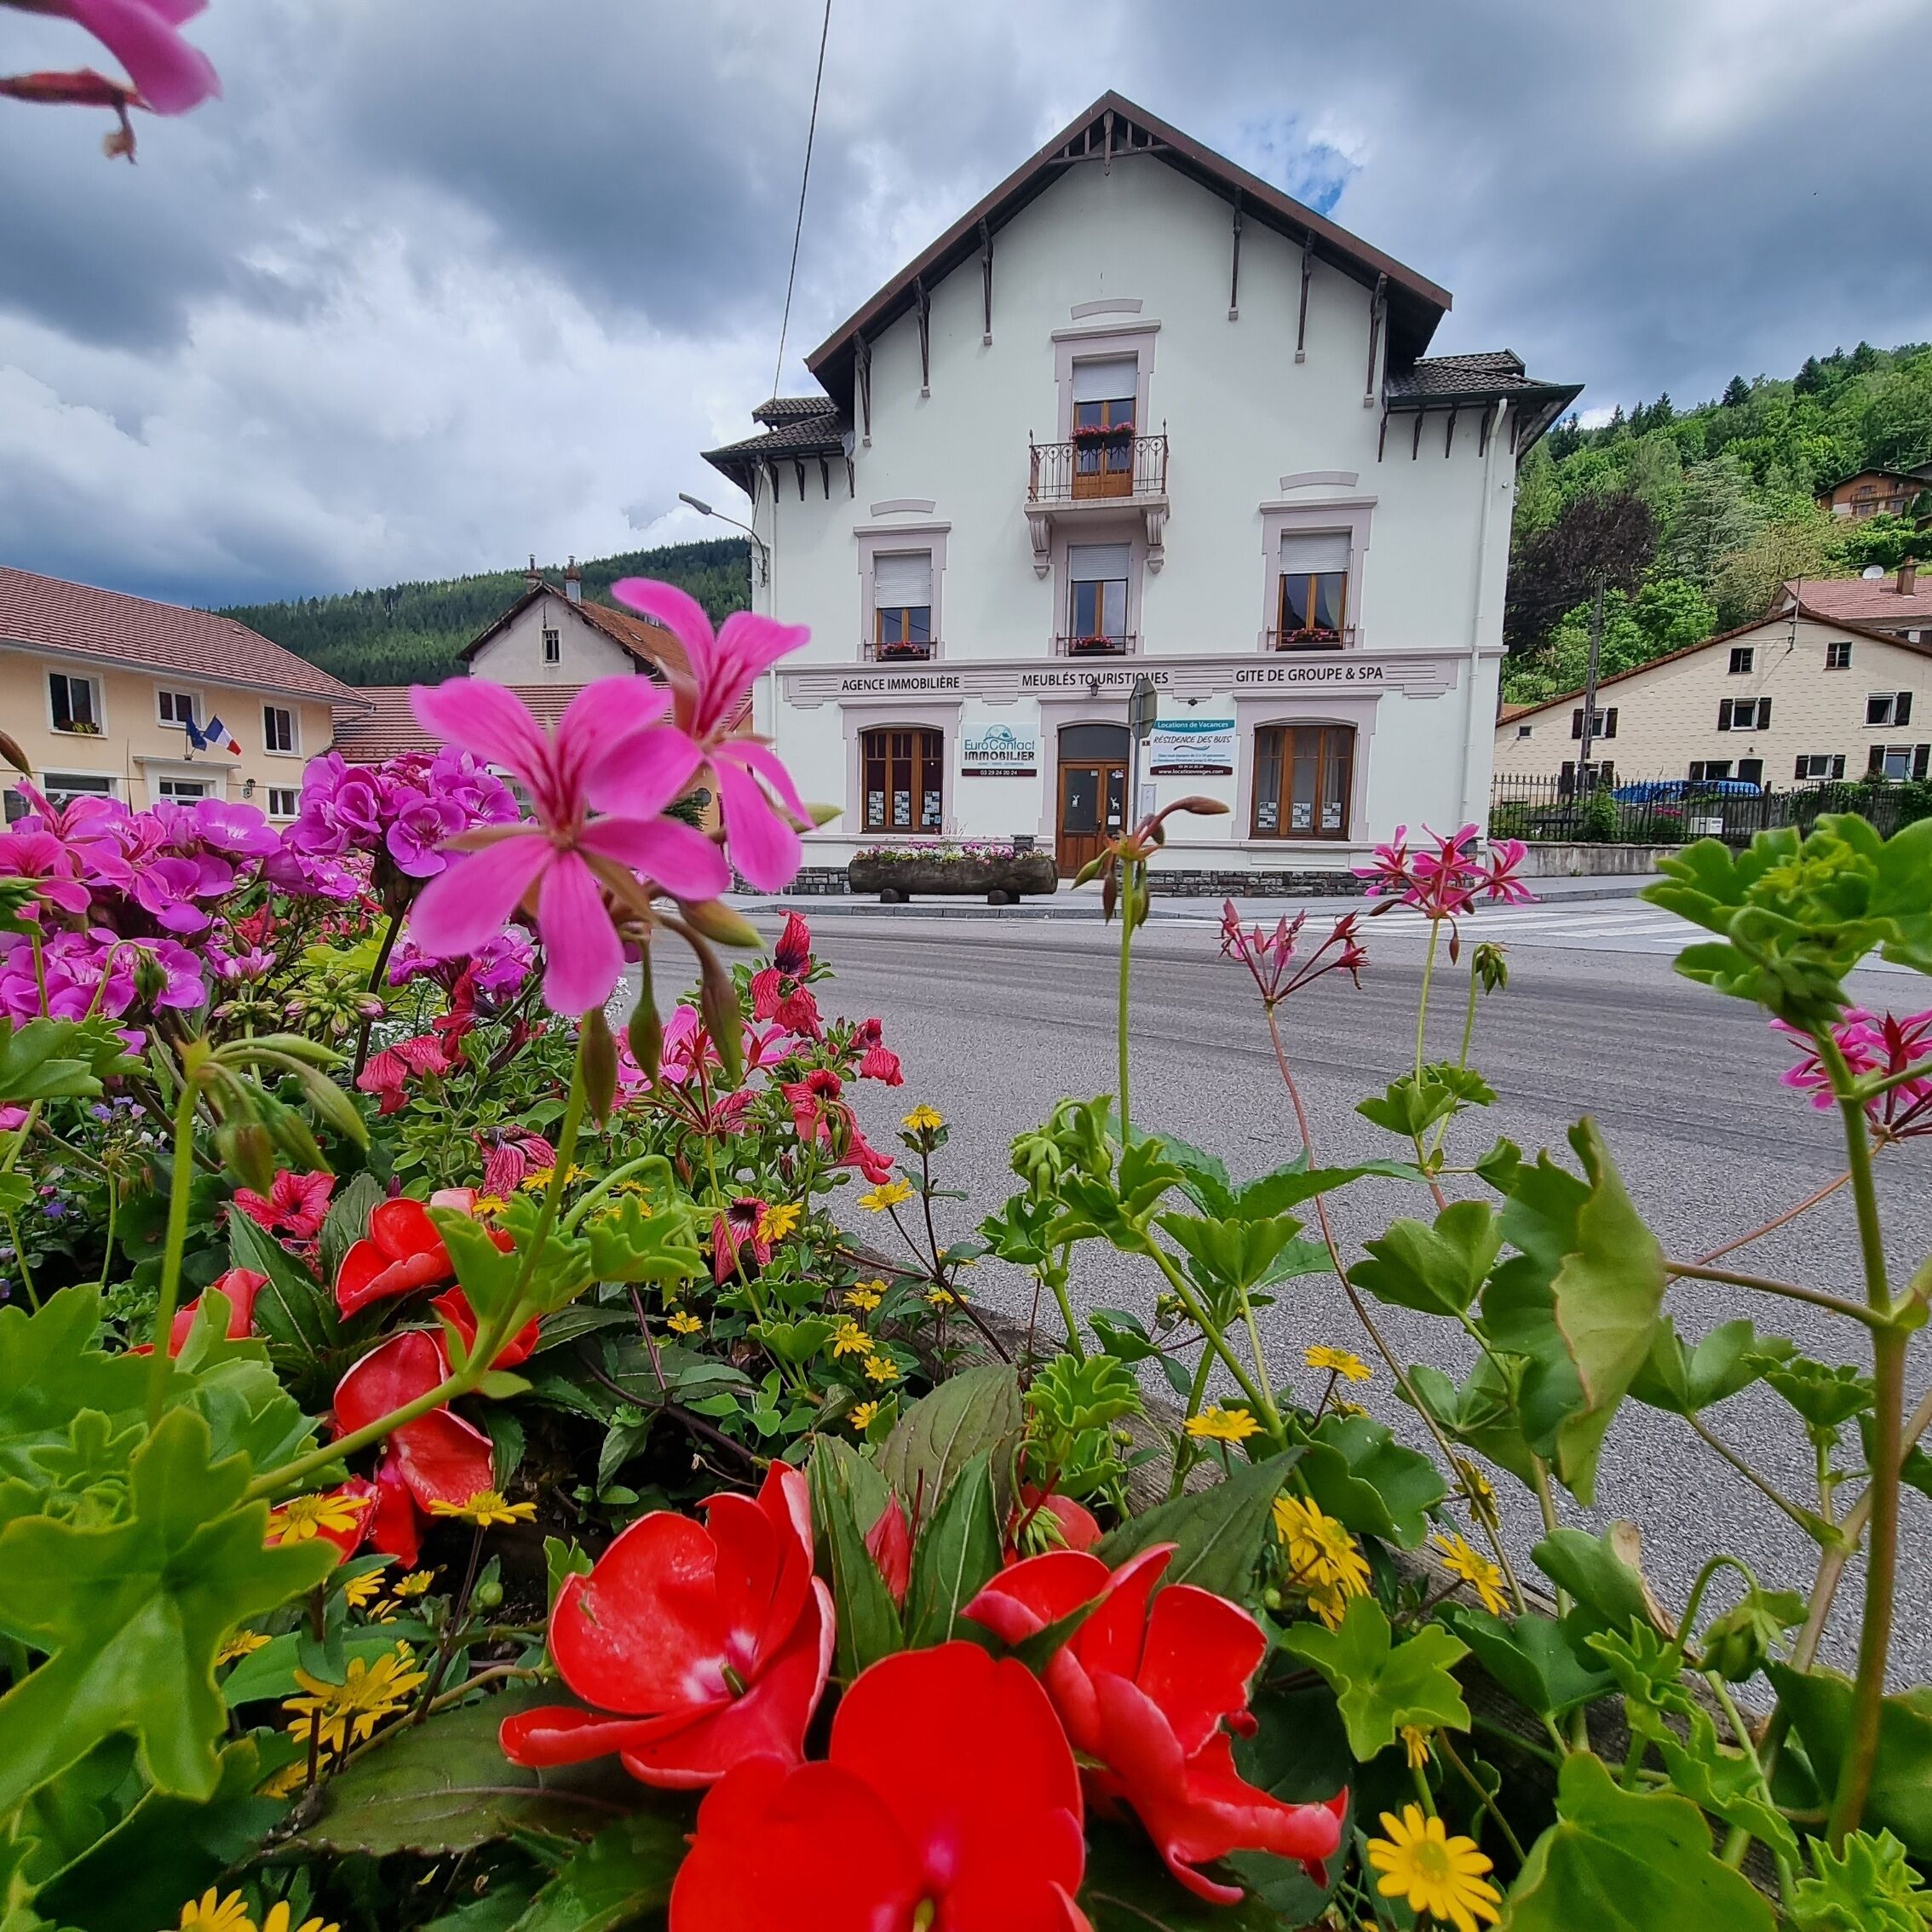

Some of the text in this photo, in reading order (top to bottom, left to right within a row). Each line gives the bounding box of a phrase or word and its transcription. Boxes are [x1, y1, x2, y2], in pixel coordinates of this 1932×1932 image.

[1022, 671, 1076, 687] MEUBLÉS
[1236, 666, 1383, 682] GITE DE GROUPE & SPA
[842, 675, 960, 691] AGENCE IMMOBILIÈRE
[964, 739, 1035, 750] EuroContact
[1153, 734, 1195, 744] RÉSIDENCE
[1197, 735, 1211, 744] DES
[964, 750, 1035, 761] IMMOBILIER
